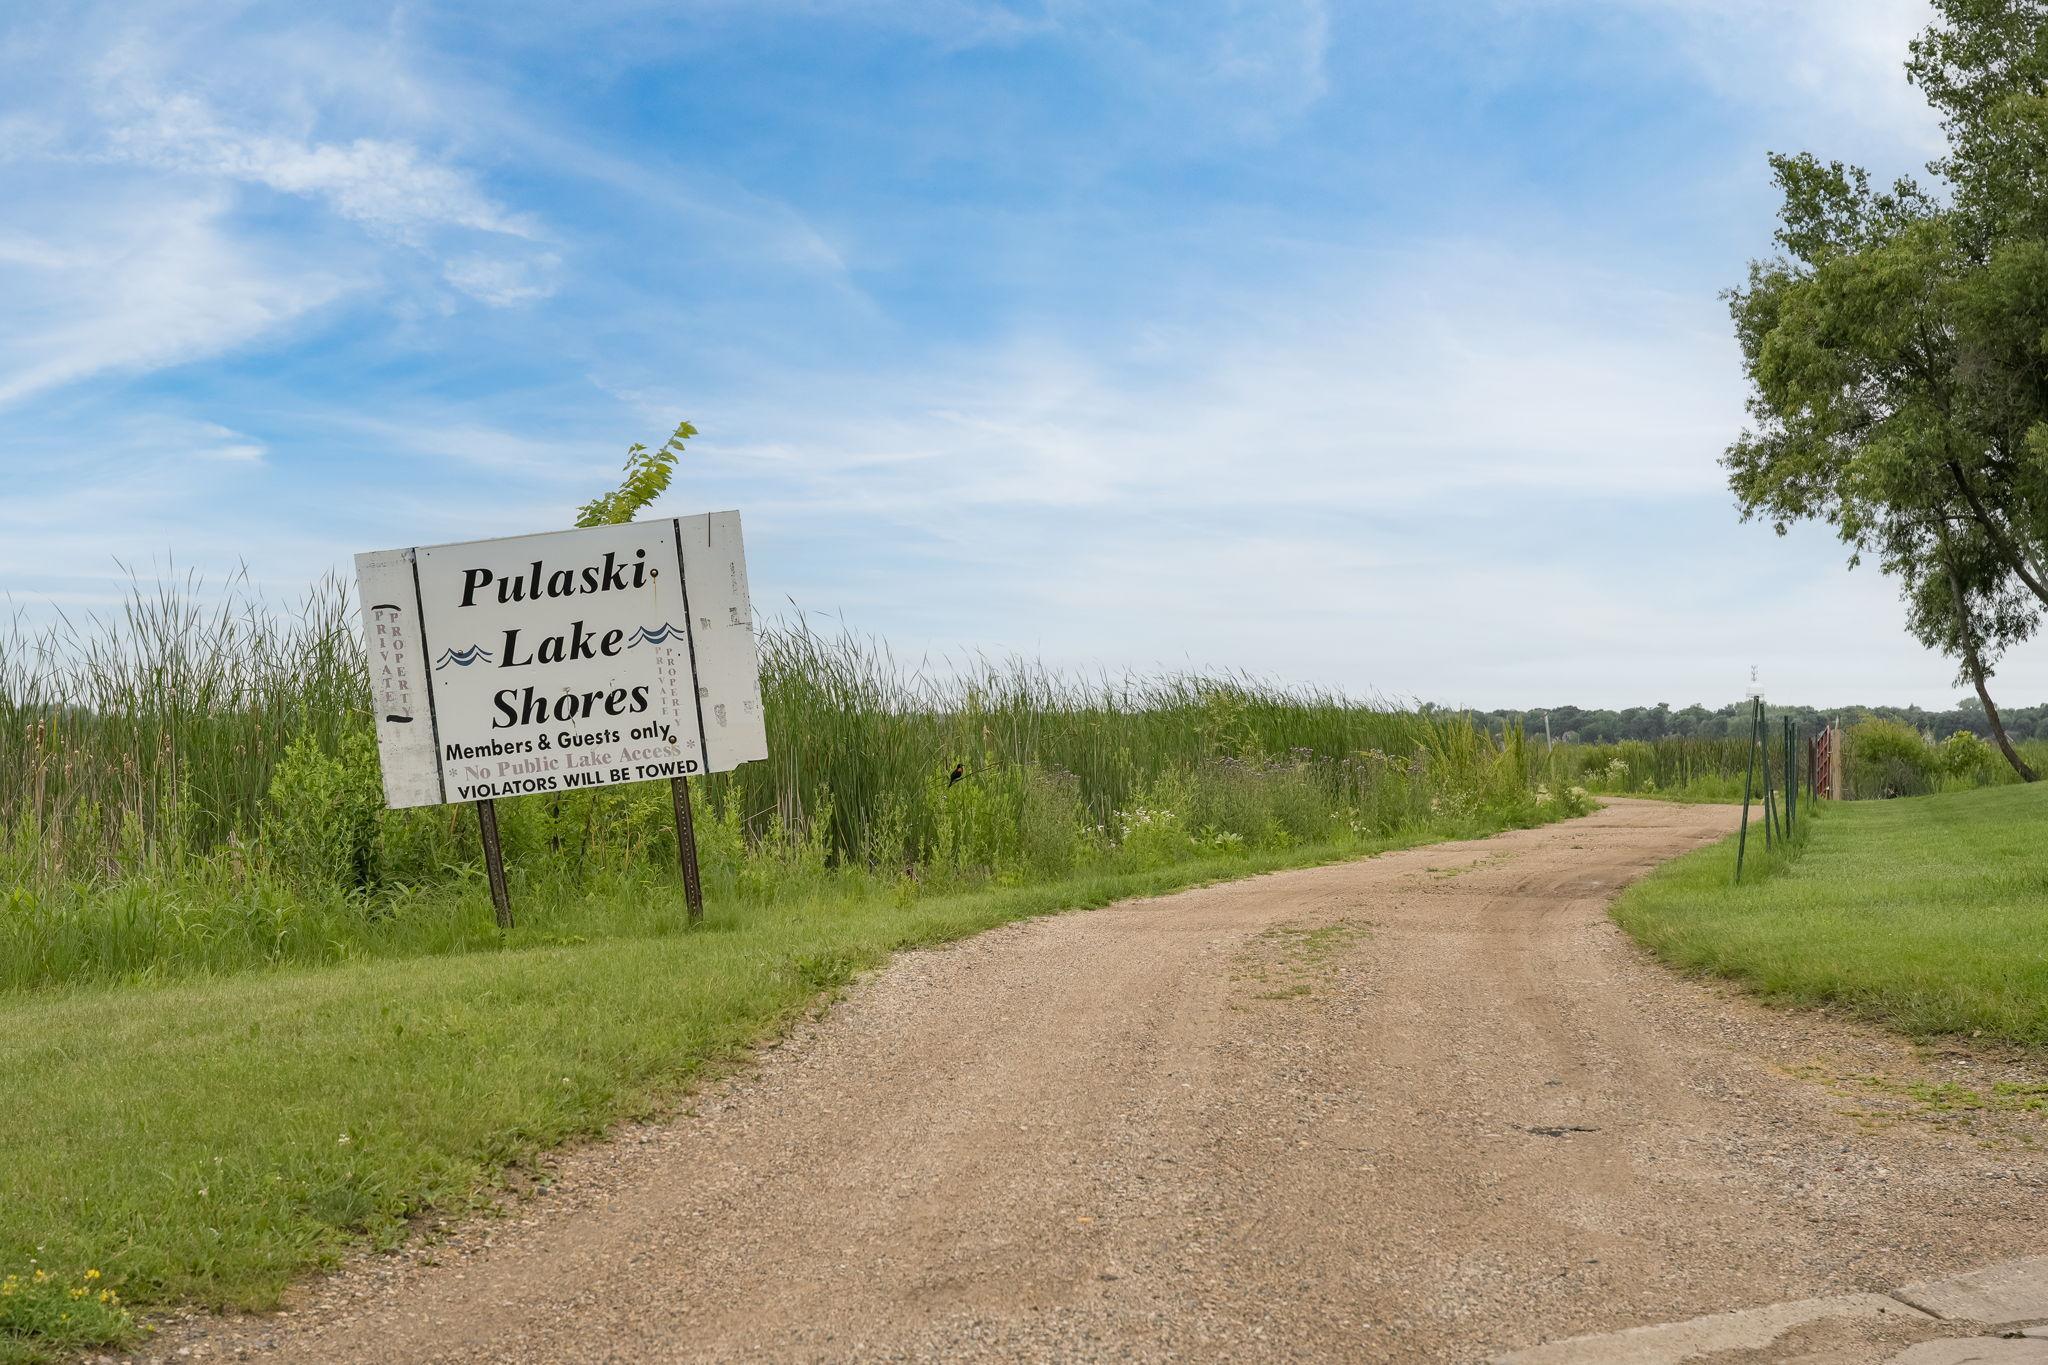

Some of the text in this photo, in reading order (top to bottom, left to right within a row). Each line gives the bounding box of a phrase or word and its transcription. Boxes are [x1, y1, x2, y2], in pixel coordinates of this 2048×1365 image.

[458, 549, 647, 607] Pulaski
[374, 610, 394, 702] PRIVATE
[390, 612, 412, 716] PROPERTY
[498, 620, 623, 668] Lake
[492, 685, 649, 729] Shores
[655, 647, 668, 715] PRIVATE
[666, 648, 680, 726] PROPERTY
[446, 720, 670, 761] Members & Guests only
[464, 744, 681, 781] No Public Lake Access
[457, 760, 698, 799] VIOLATORS WILL BE TOWED
